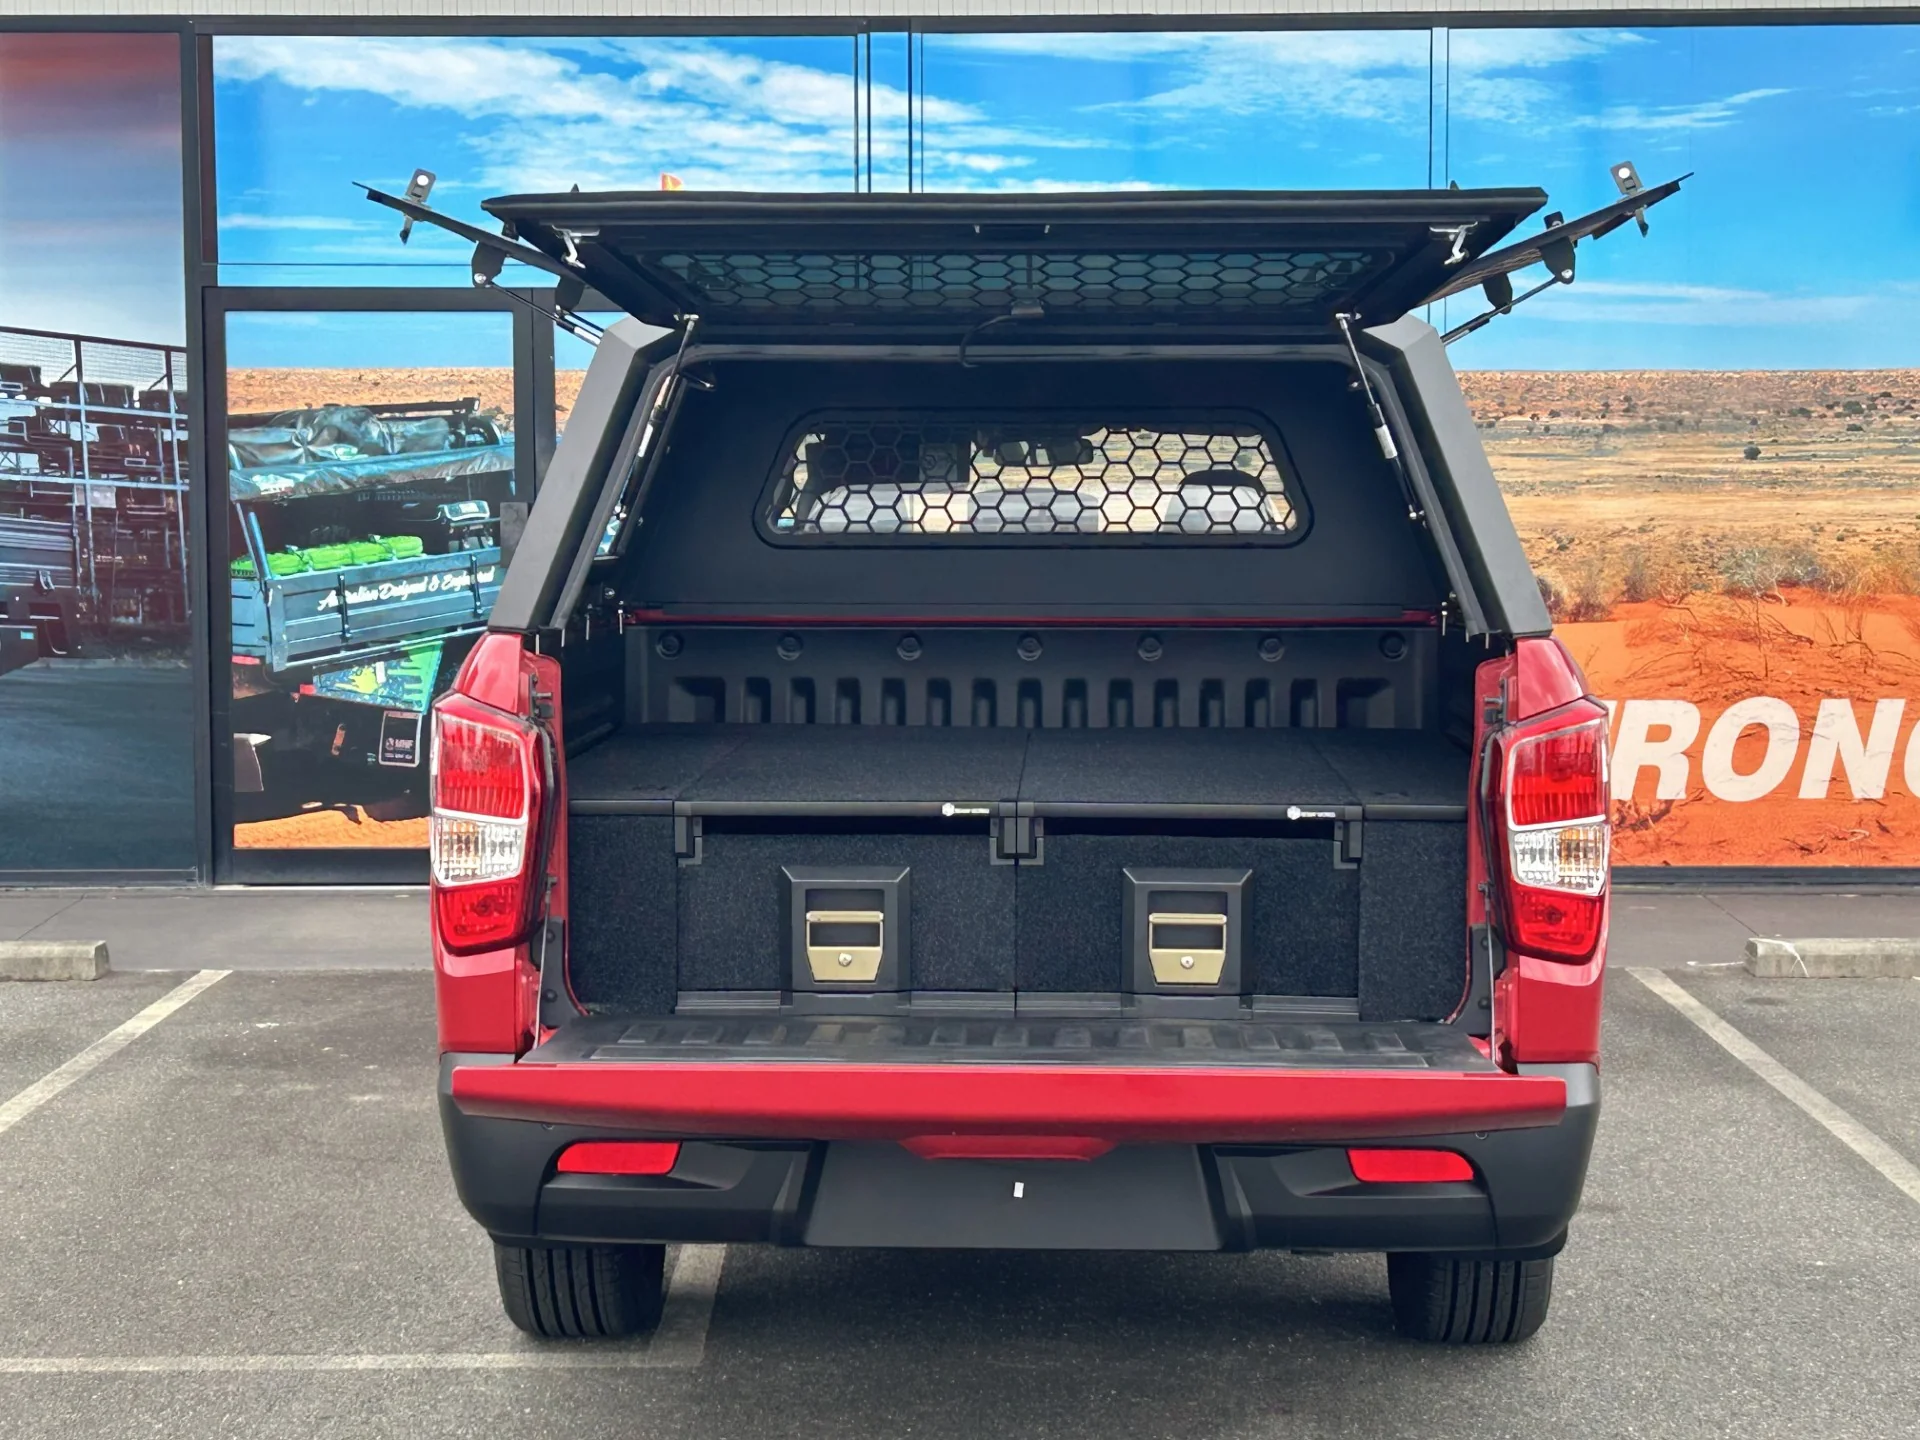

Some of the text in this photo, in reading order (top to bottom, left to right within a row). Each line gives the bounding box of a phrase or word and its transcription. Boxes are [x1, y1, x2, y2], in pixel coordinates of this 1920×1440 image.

[317, 566, 495, 611] Auralian Designed & Enginred
